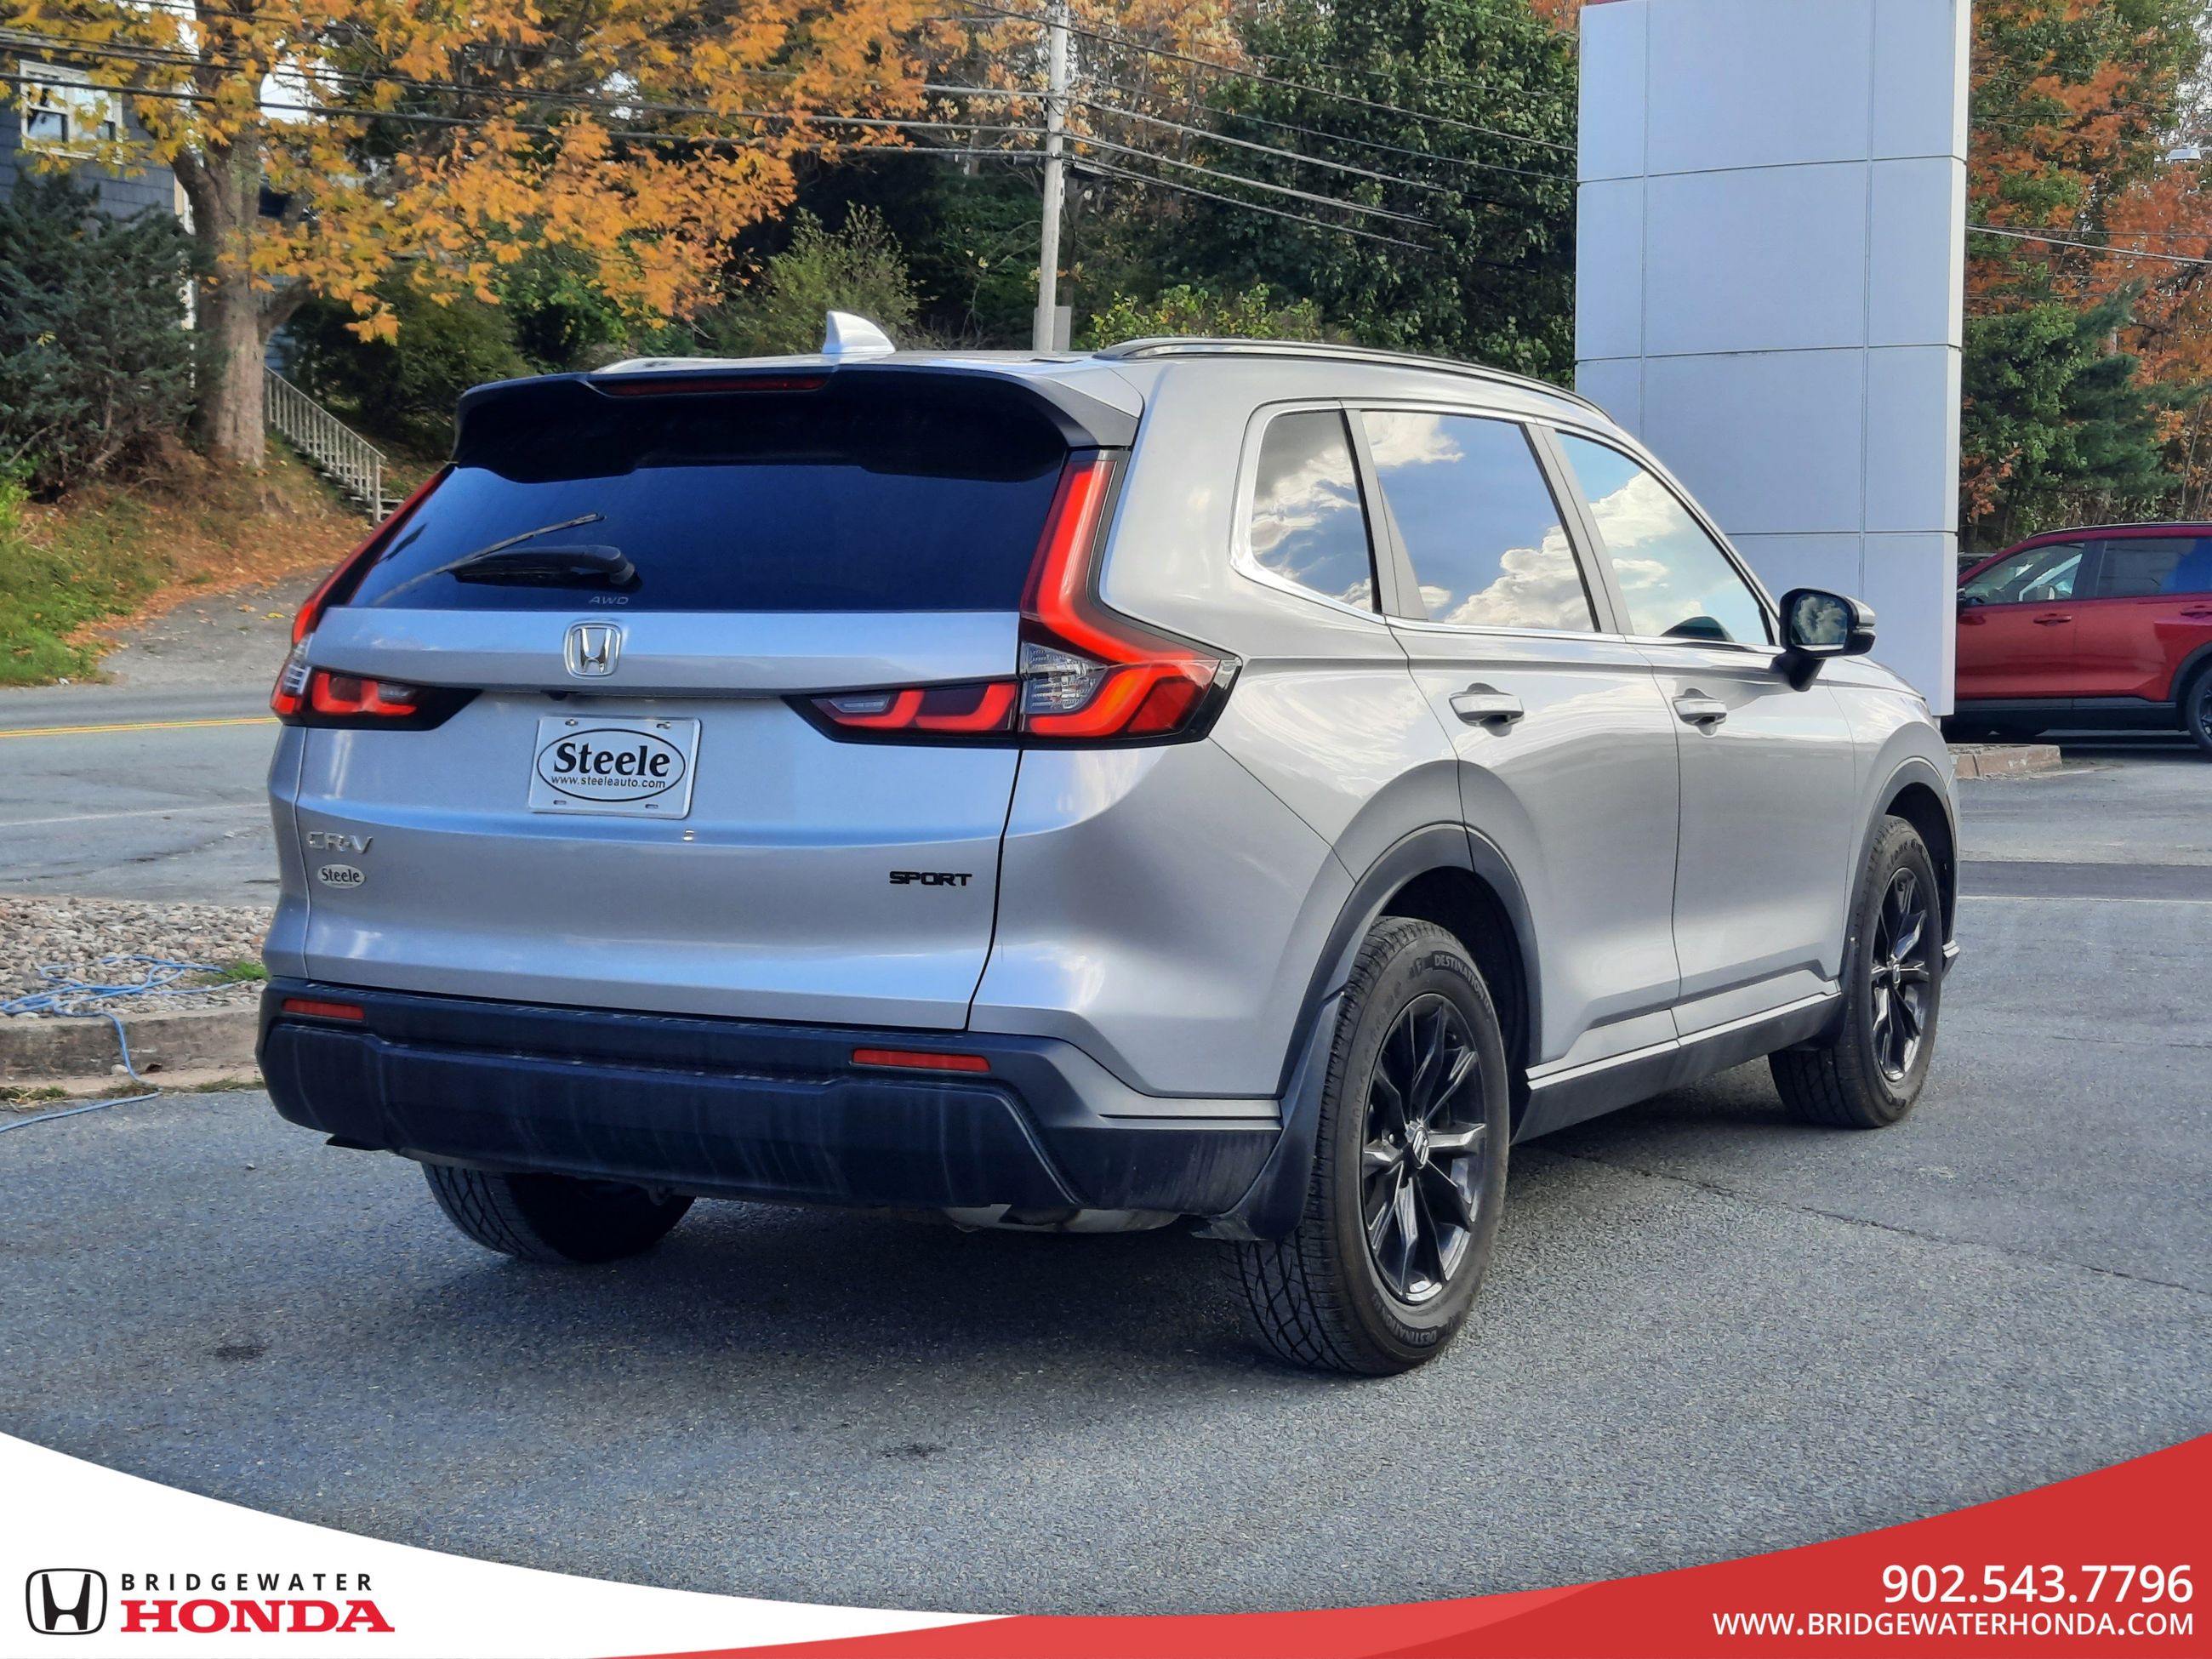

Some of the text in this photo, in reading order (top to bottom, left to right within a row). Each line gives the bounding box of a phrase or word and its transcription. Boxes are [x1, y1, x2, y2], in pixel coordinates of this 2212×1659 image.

[589, 596, 629, 605] AWD
[554, 742, 671, 778] Steele
[551, 775, 666, 789] www.steeleauto.com
[307, 831, 373, 855] CR-V
[321, 868, 361, 883] Steele
[889, 870, 972, 887] SPORT
